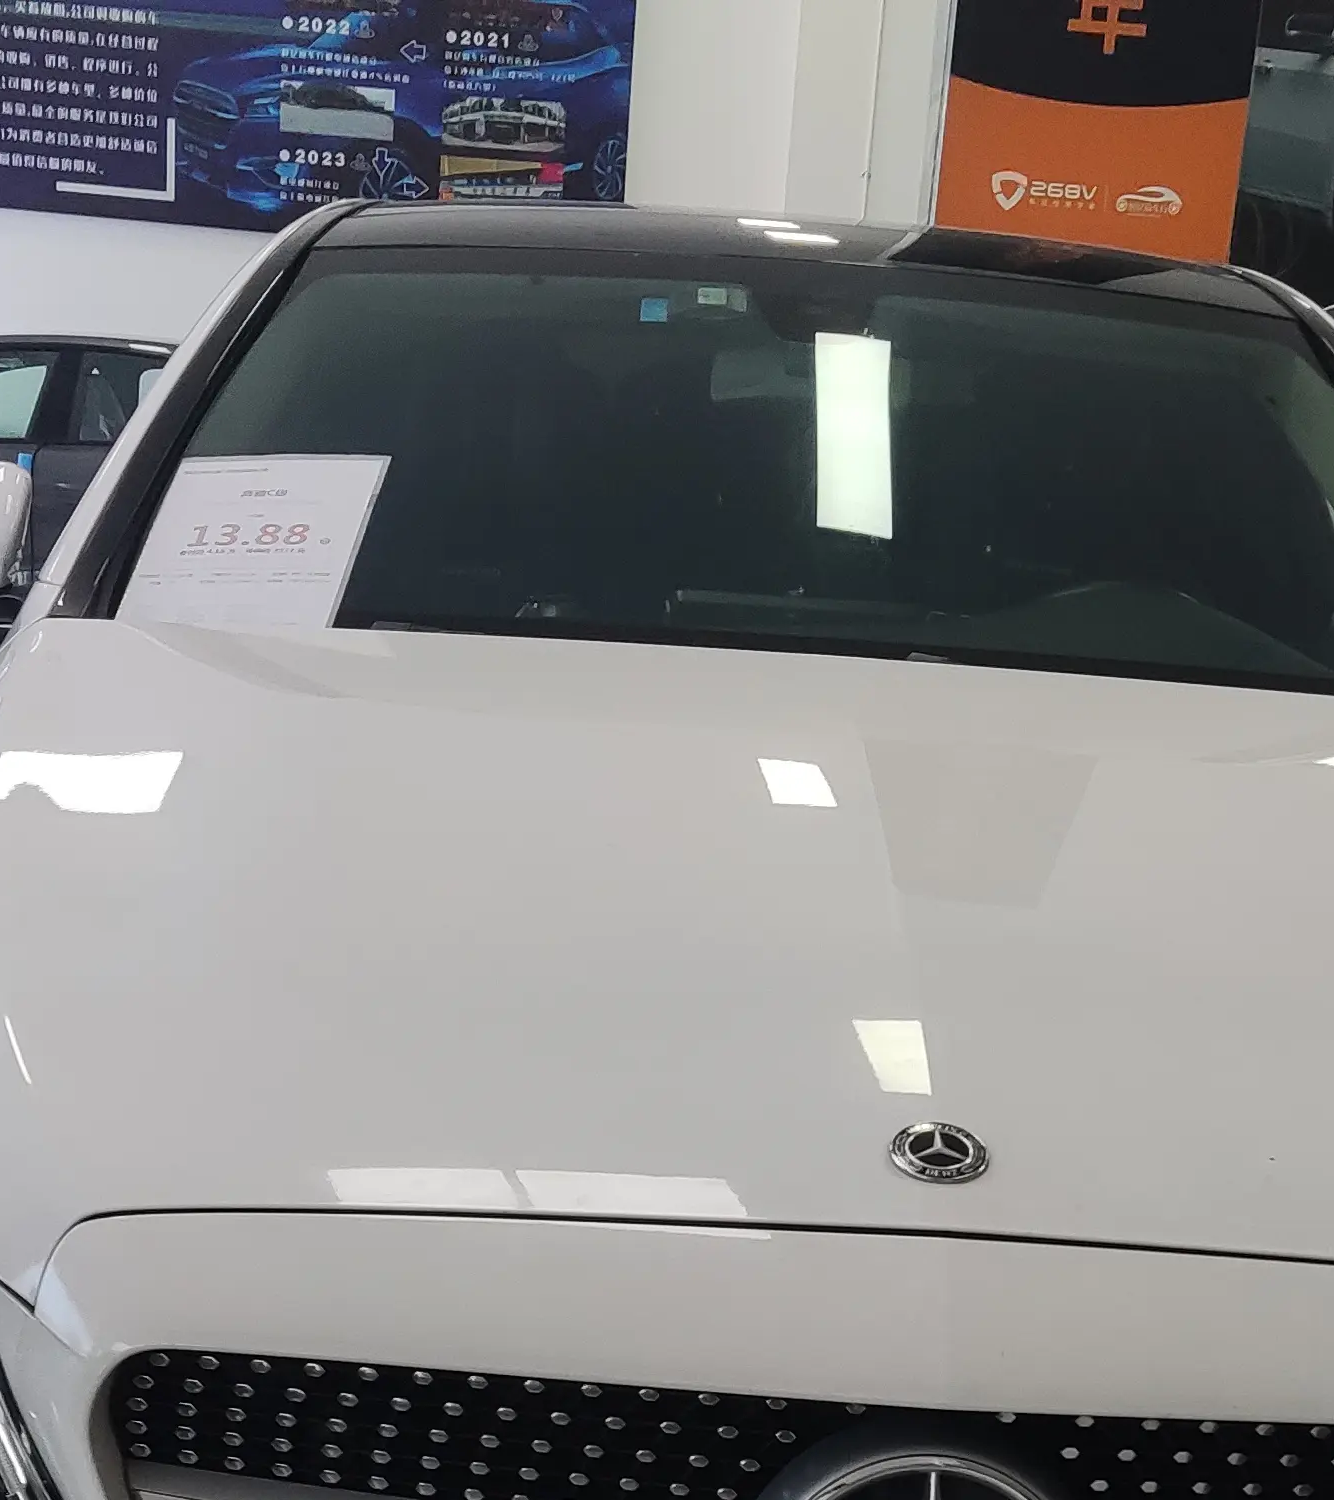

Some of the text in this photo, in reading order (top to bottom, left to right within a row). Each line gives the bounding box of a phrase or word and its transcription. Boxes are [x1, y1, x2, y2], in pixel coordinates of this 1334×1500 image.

[298, 15, 351, 36] 2022
[459, 29, 510, 49] 2021
[294, 147, 347, 168] 2023
[1029, 180, 1098, 200] 268V
[186, 522, 311, 548] 13.88
